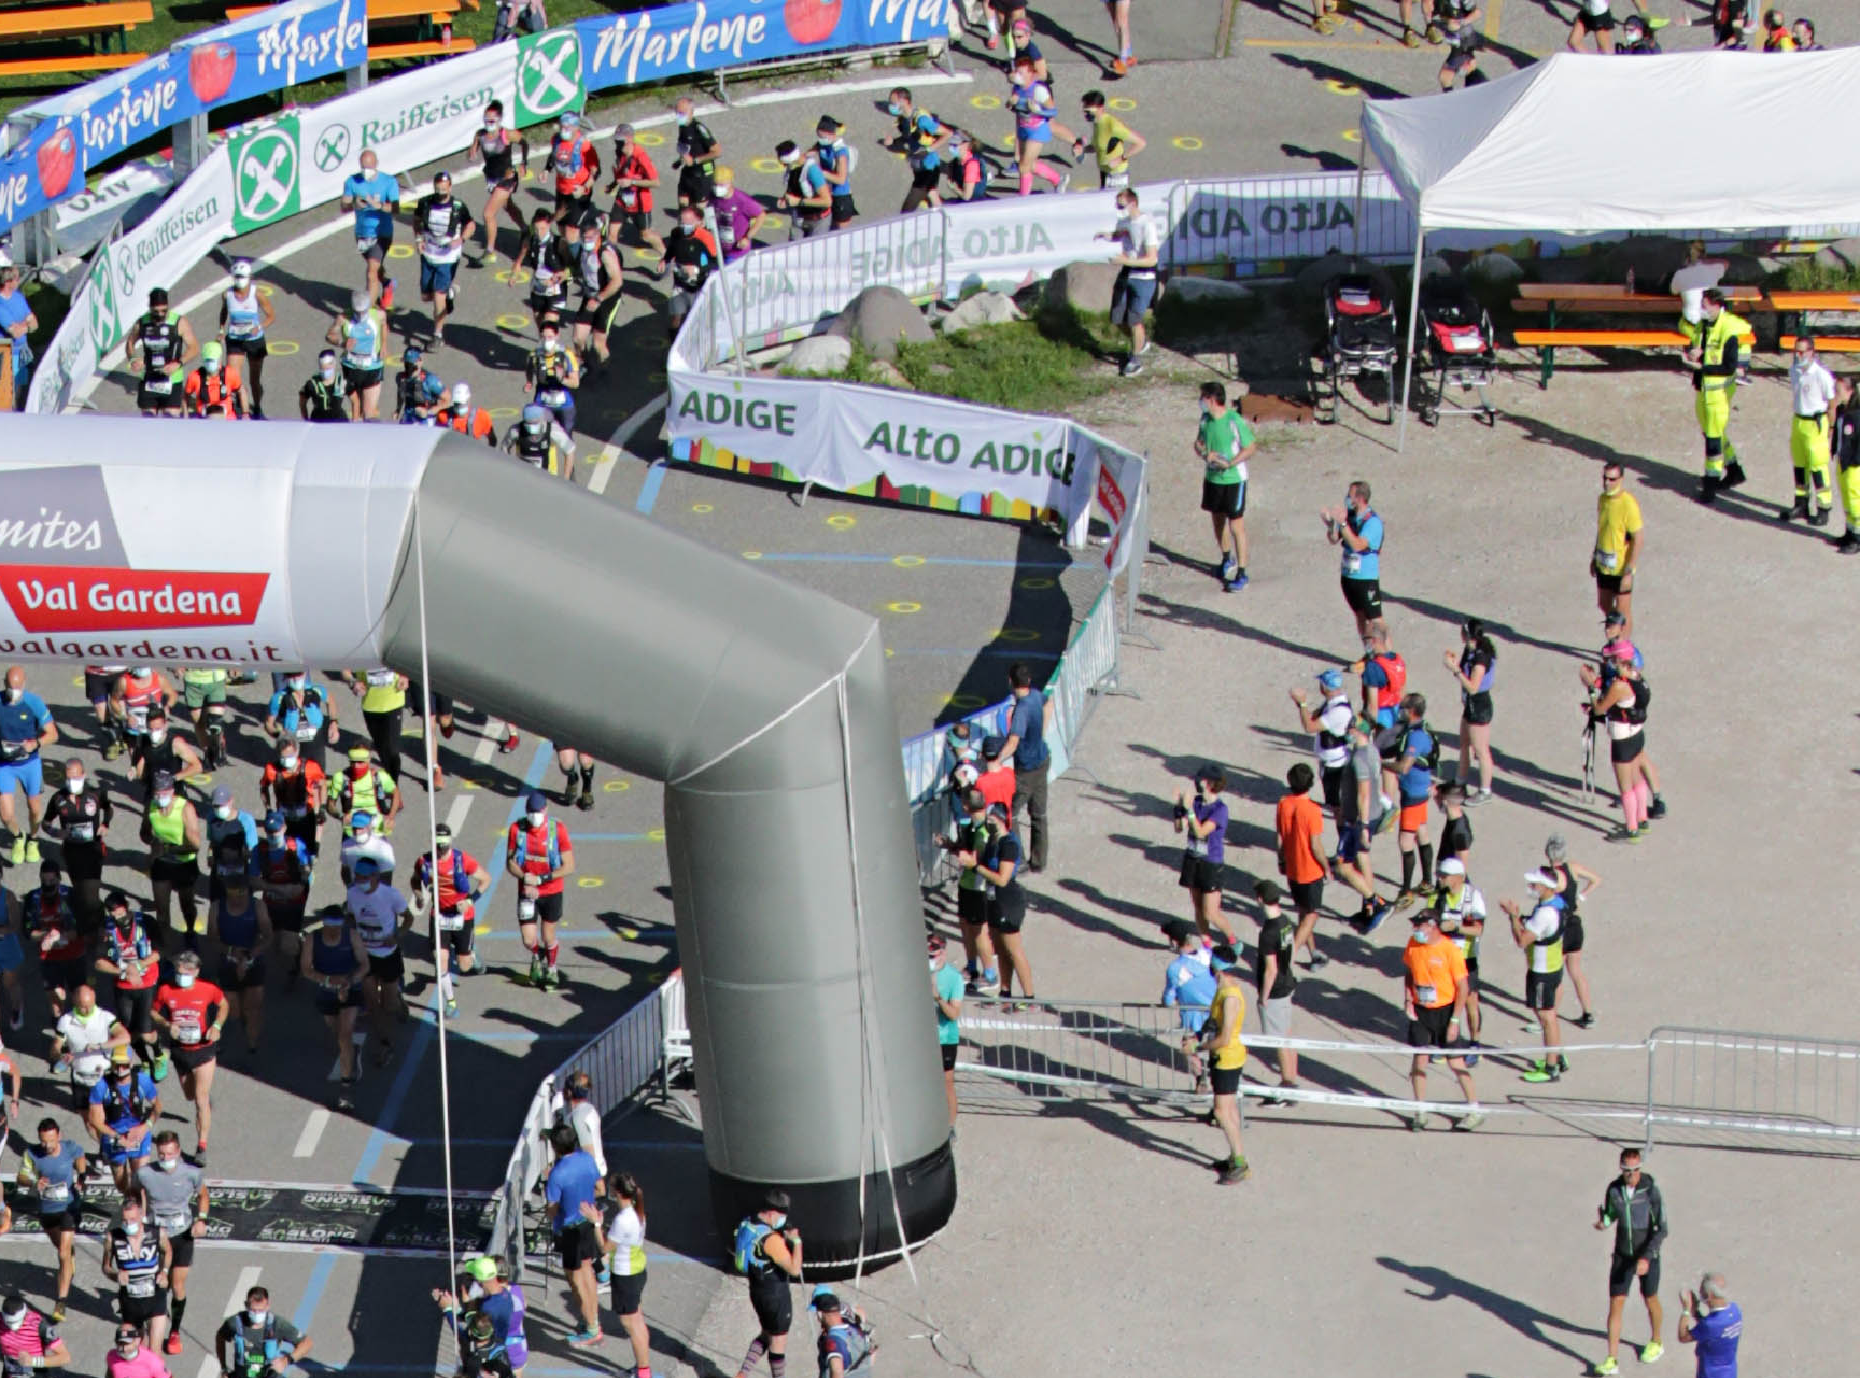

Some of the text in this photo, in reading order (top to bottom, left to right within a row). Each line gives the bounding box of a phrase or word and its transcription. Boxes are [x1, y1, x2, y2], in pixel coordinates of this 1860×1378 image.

[257, 0, 367, 85] Marle
[592, 5, 766, 84] Marlene
[359, 85, 495, 149] Raiffeisen
[136, 194, 219, 272] Raiffeisen
[16, 578, 243, 617] Val Gardena
